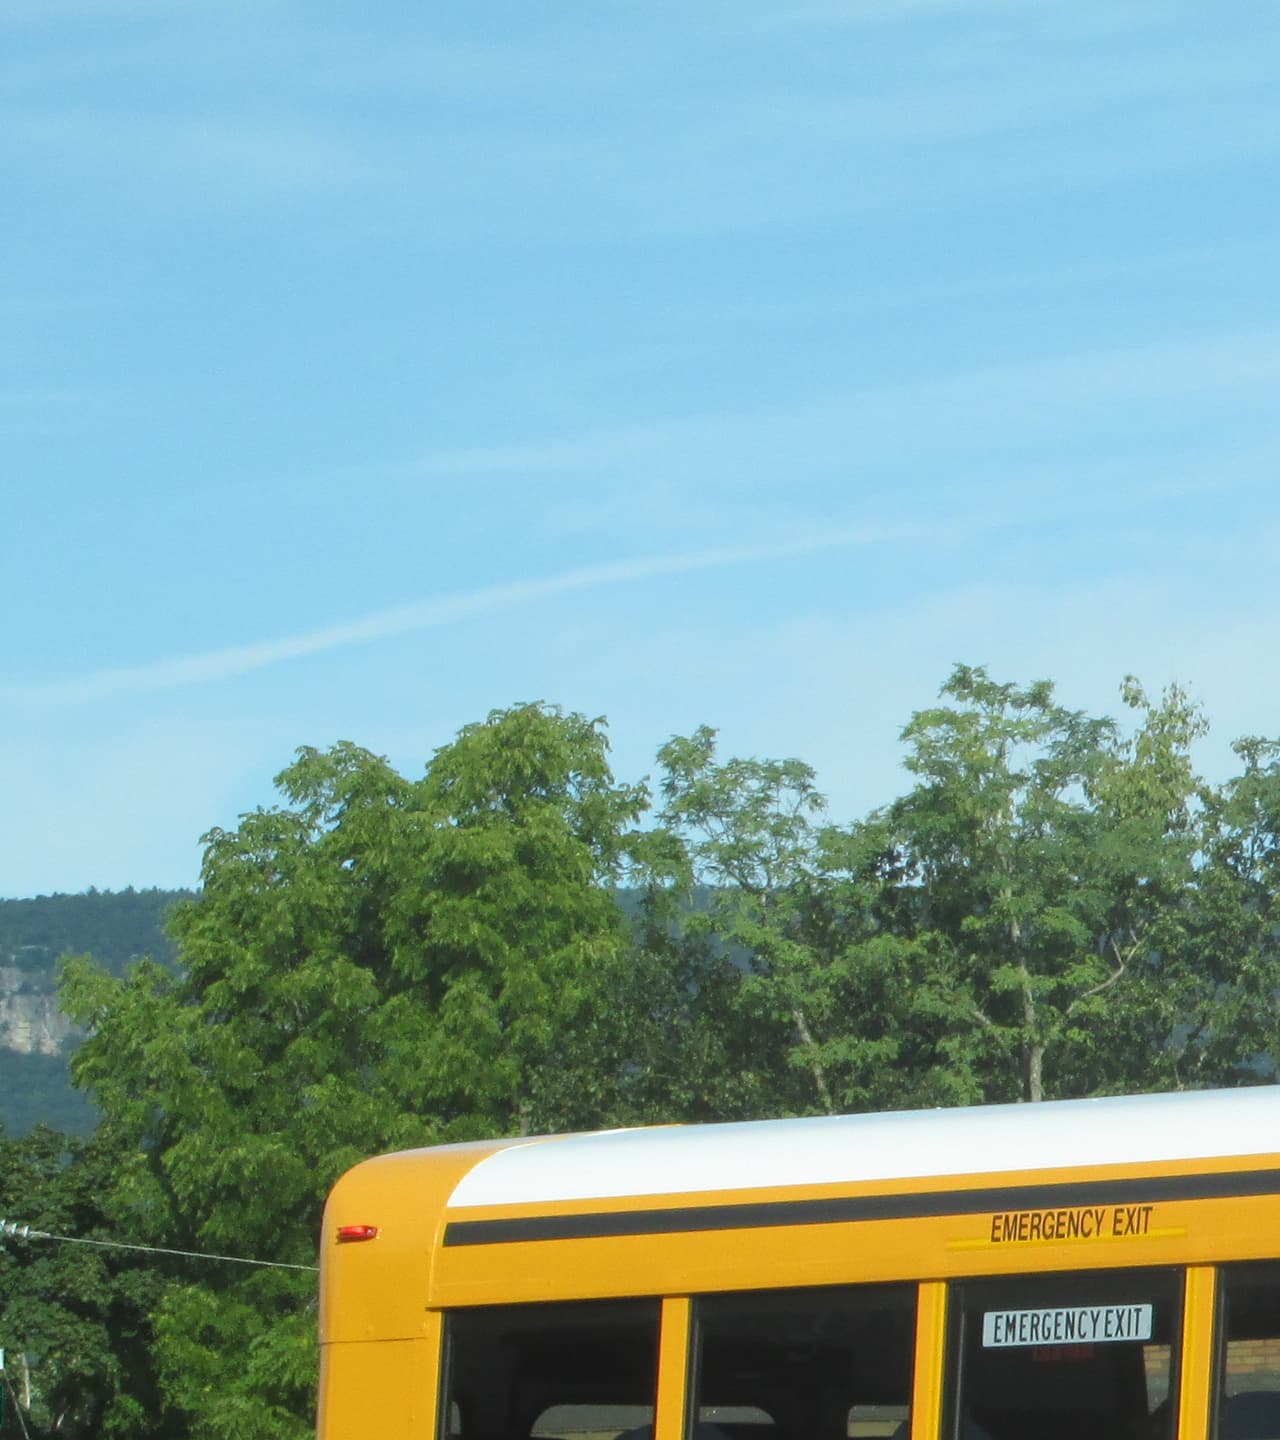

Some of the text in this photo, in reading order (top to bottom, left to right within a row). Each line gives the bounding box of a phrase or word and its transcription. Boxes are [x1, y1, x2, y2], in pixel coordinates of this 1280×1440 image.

[991, 1206, 1152, 1242] EMERGENCY EXIT
[994, 1308, 1143, 1343] EMERGENCY EXIT
